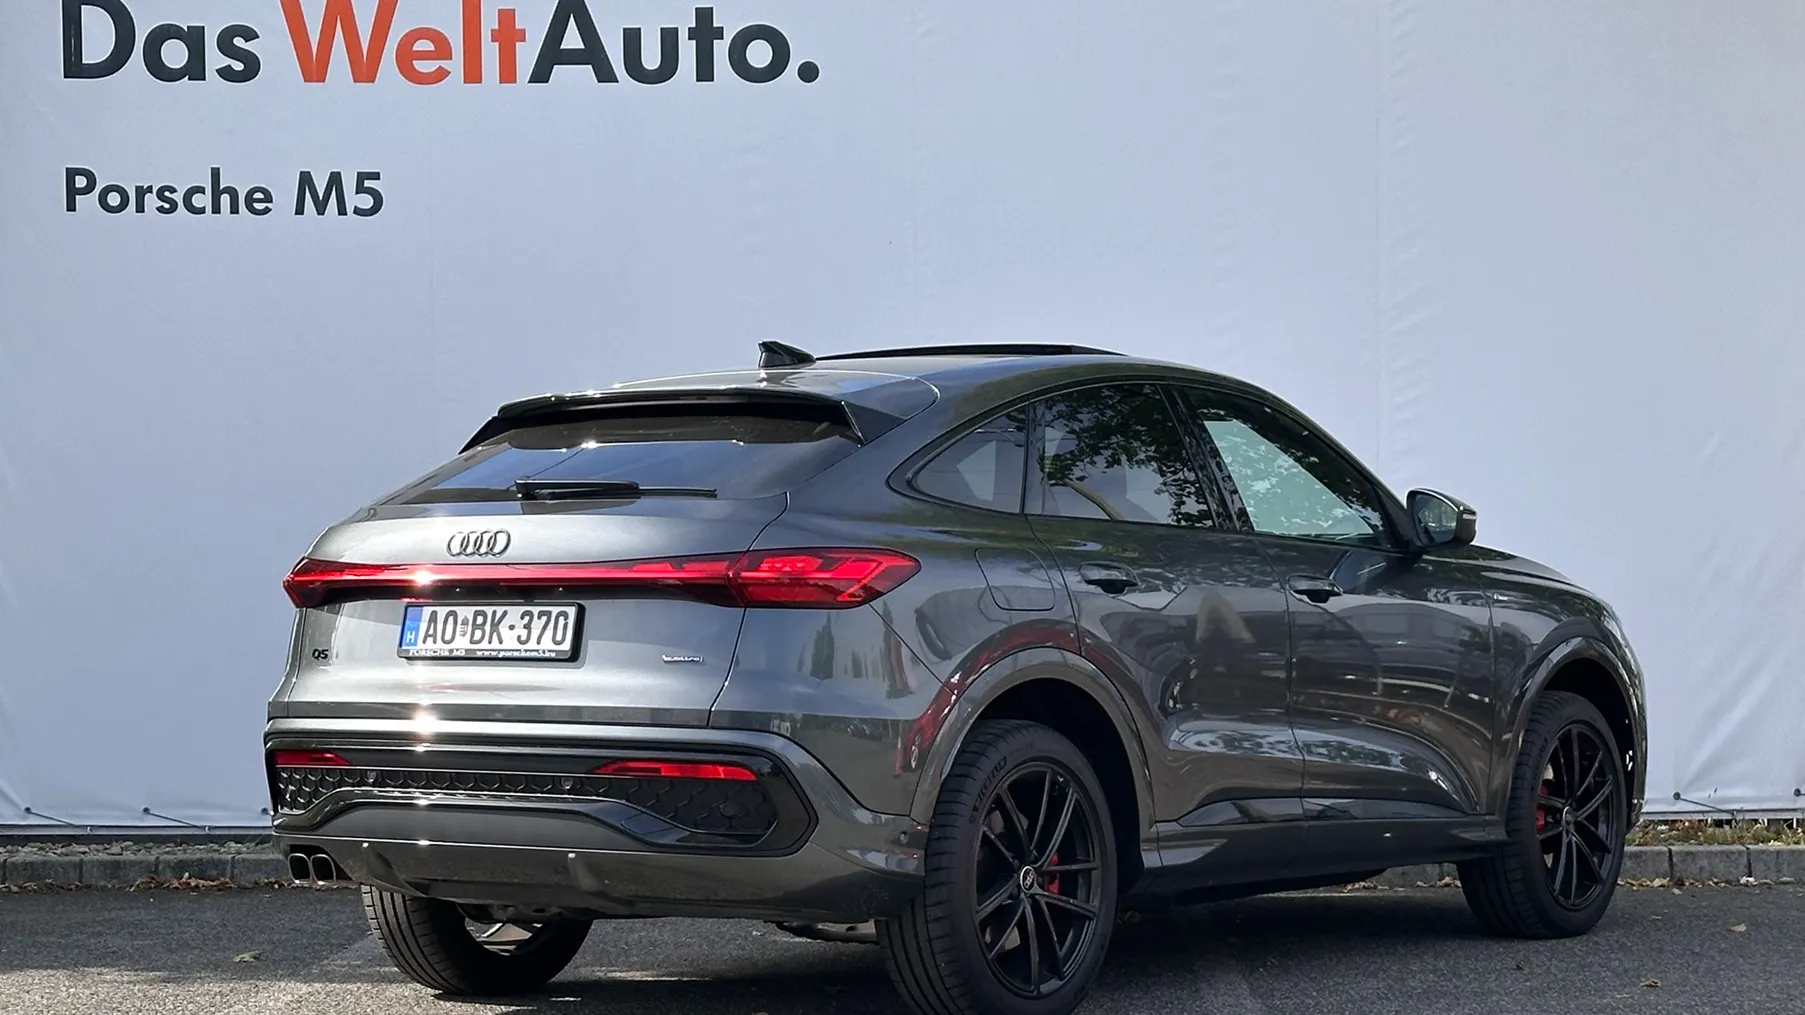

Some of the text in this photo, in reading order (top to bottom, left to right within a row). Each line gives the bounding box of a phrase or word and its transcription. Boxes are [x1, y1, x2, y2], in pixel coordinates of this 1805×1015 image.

[62, 0, 262, 83] Das
[64, 166, 384, 218] Porsche M5
[406, 631, 415, 643] H
[312, 648, 329, 660] Q5
